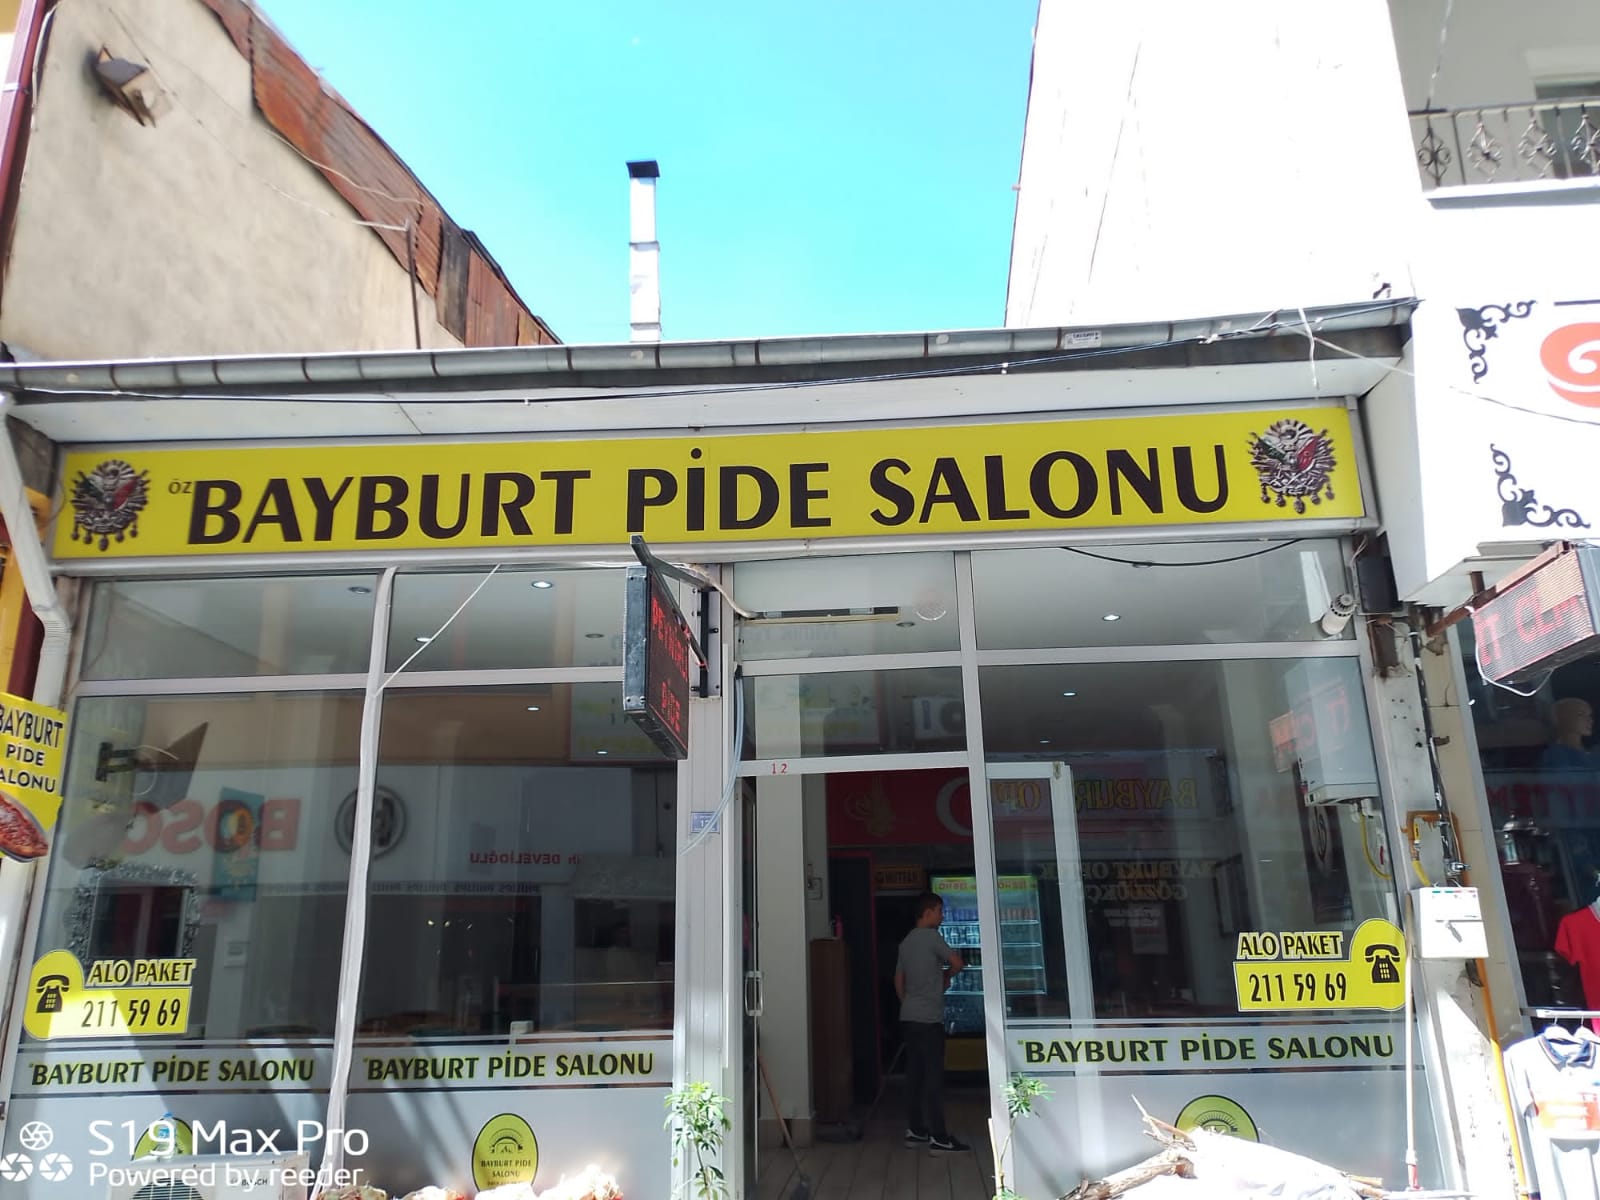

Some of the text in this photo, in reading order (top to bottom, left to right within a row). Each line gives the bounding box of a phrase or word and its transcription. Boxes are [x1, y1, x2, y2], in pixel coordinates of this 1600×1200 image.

[168, 444, 1229, 545] ÖZ BAYBURT PİDE SALONU
[6, 742, 44, 767] PİDE
[0, 767, 56, 793] ALONU
[1239, 932, 1342, 957] ALO PAKET
[89, 961, 193, 983] ALO PAKET
[1248, 972, 1347, 1002] 211 59 69
[81, 998, 181, 1028] 211 59 69
[1025, 1032, 1394, 1064] BAYBURT PİDE SALONU
[31, 1055, 315, 1086] BAYBURT PİDE SALONU
[367, 1049, 654, 1081] BAYBURT PİDE SALONU
